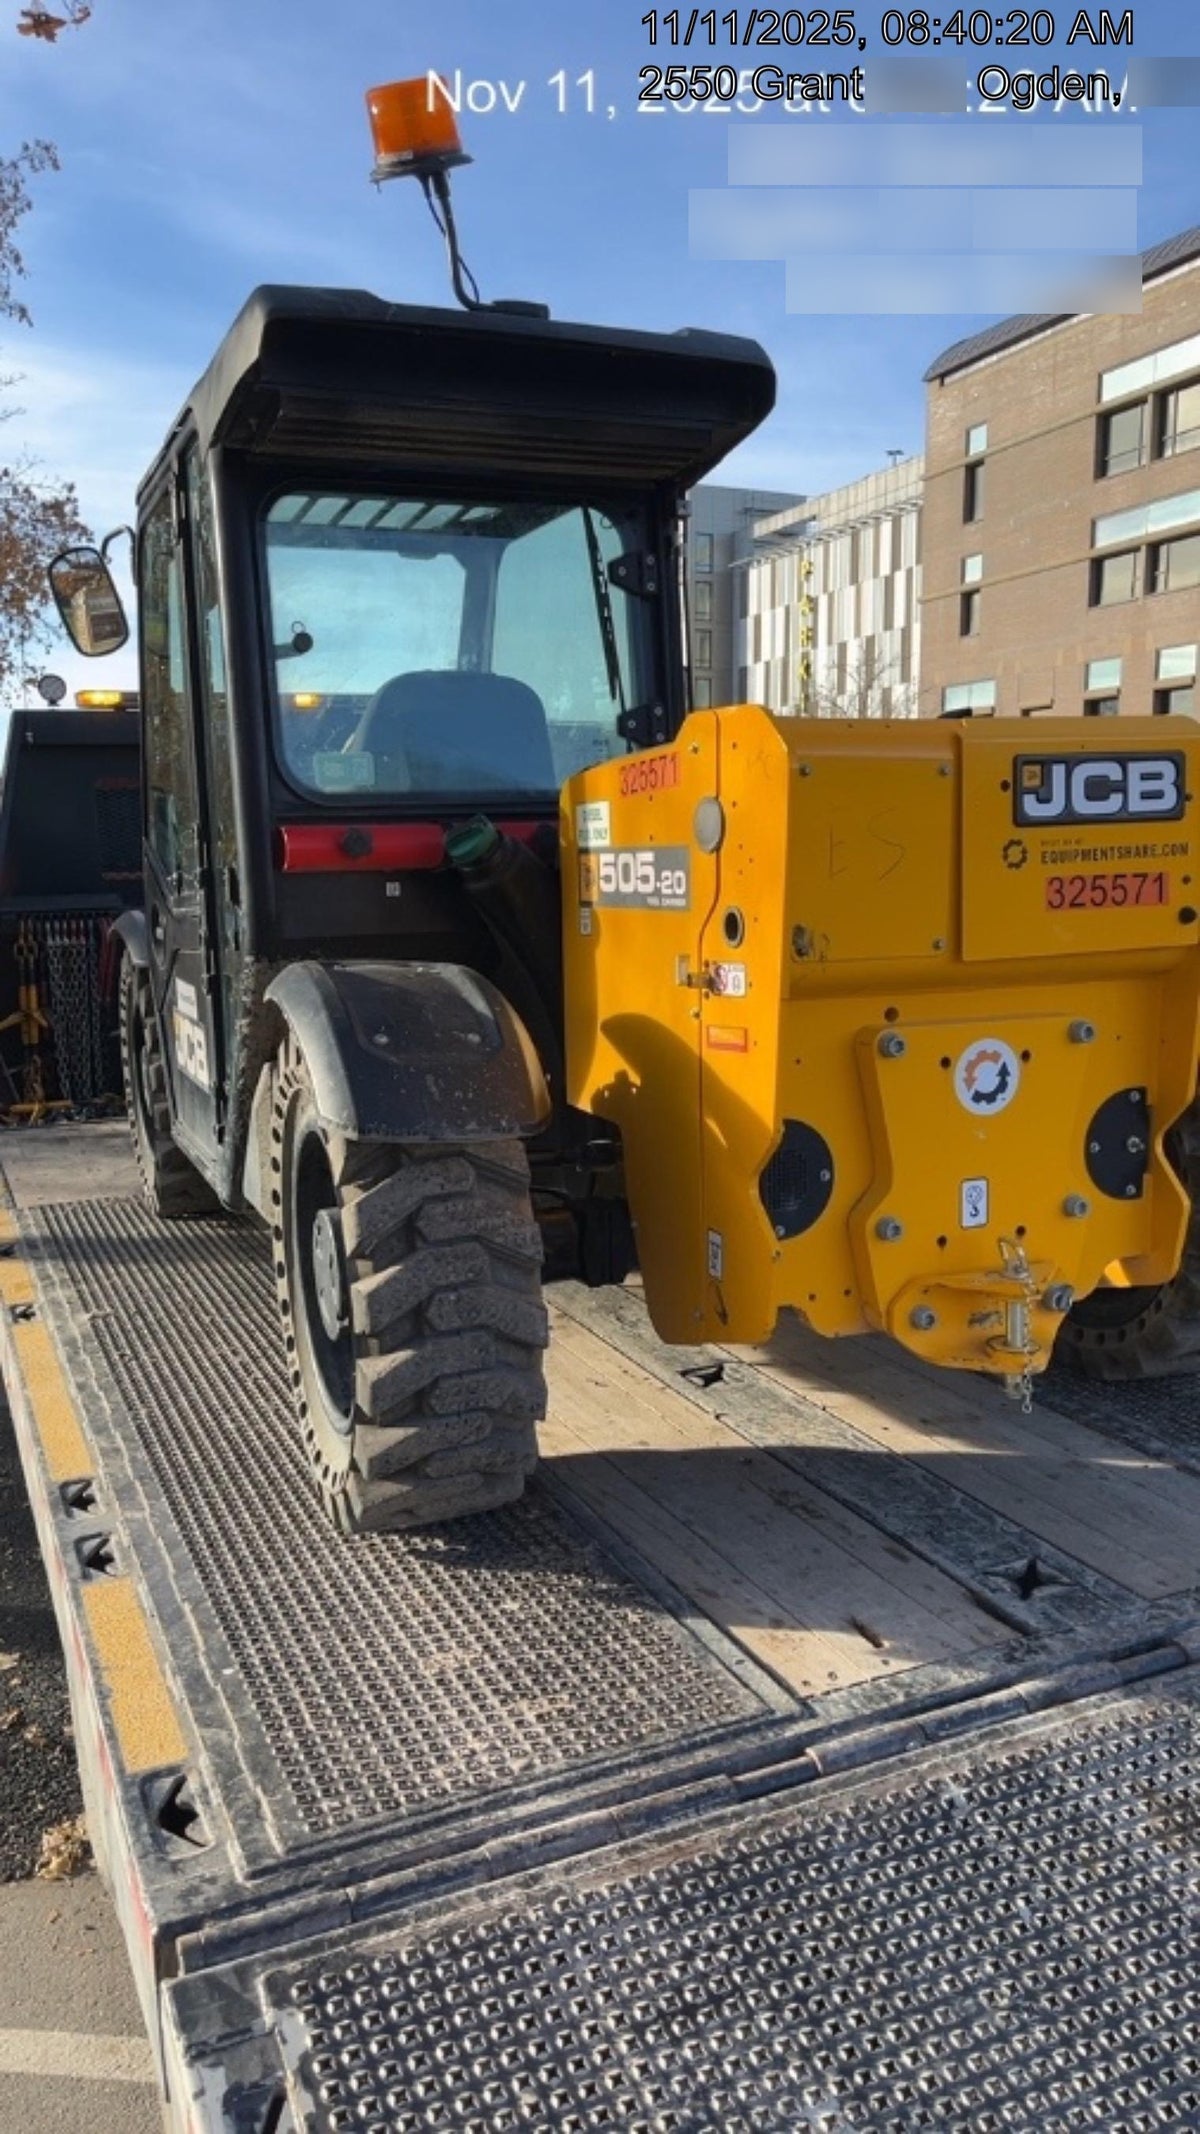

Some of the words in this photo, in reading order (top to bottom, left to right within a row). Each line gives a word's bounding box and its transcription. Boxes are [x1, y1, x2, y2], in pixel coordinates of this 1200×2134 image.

[619, 752, 677, 796] 325571
[1022, 760, 1177, 816] JCB
[1041, 842, 1189, 865] EQUIPMENTSHARE.COM
[1047, 871, 1164, 909] 325571
